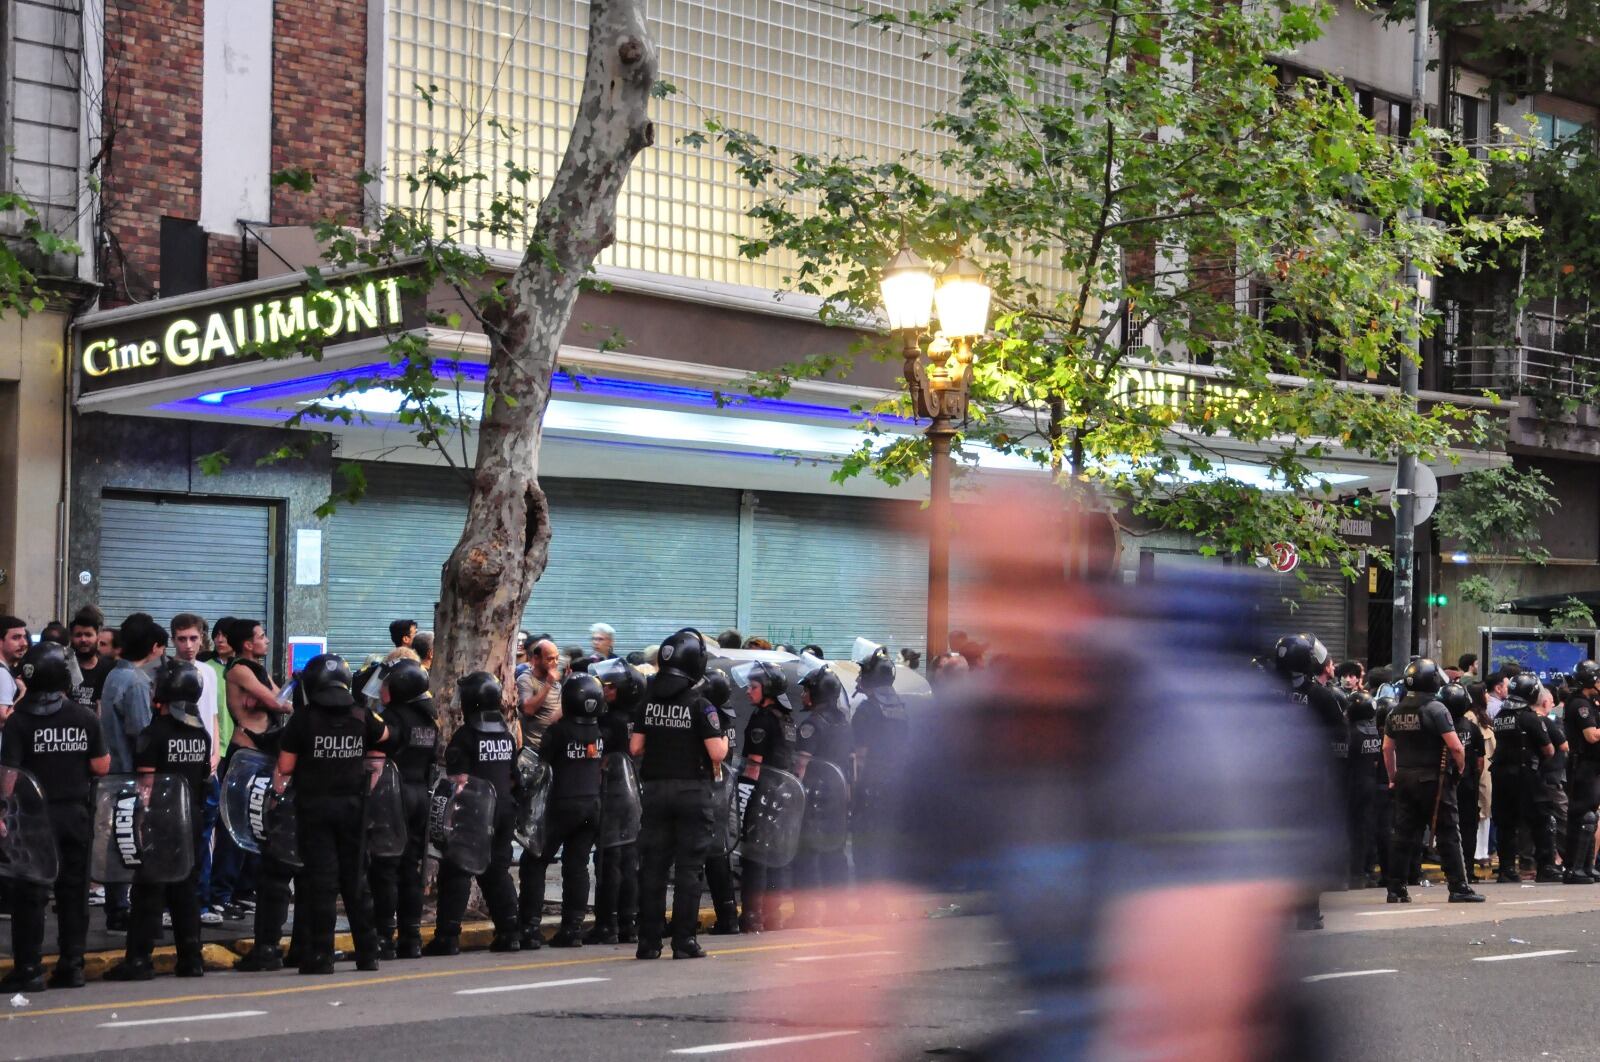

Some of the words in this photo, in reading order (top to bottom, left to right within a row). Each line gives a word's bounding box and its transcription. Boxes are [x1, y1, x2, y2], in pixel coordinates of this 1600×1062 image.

[83, 337, 161, 378] Cine
[645, 703, 692, 720] POLICIA
[644, 717, 654, 725] DE
[655, 718, 664, 726] LA
[665, 719, 692, 729] CIUDAD
[34, 727, 88, 743] POLICIA
[34, 743, 45, 753] DE
[47, 743, 59, 752] LA
[60, 741, 88, 752] CIUDAD
[168, 738, 206, 753] POLICIA
[314, 735, 364, 750] POLICIA
[479, 740, 513, 753] POLICIA
[567, 738, 604, 751] POLIA
[167, 753, 178, 762] DE
[179, 753, 188, 762] LA
[313, 749, 324, 758] DE
[326, 750, 337, 758] LA
[338, 748, 363, 758] CIUDAD
[479, 753, 488, 761] DE
[489, 753, 497, 761] LA
[567, 751, 576, 759] DE
[577, 751, 586, 759] LA
[249, 776, 271, 842] POLICIA
[115, 796, 142, 866] POLICIA
